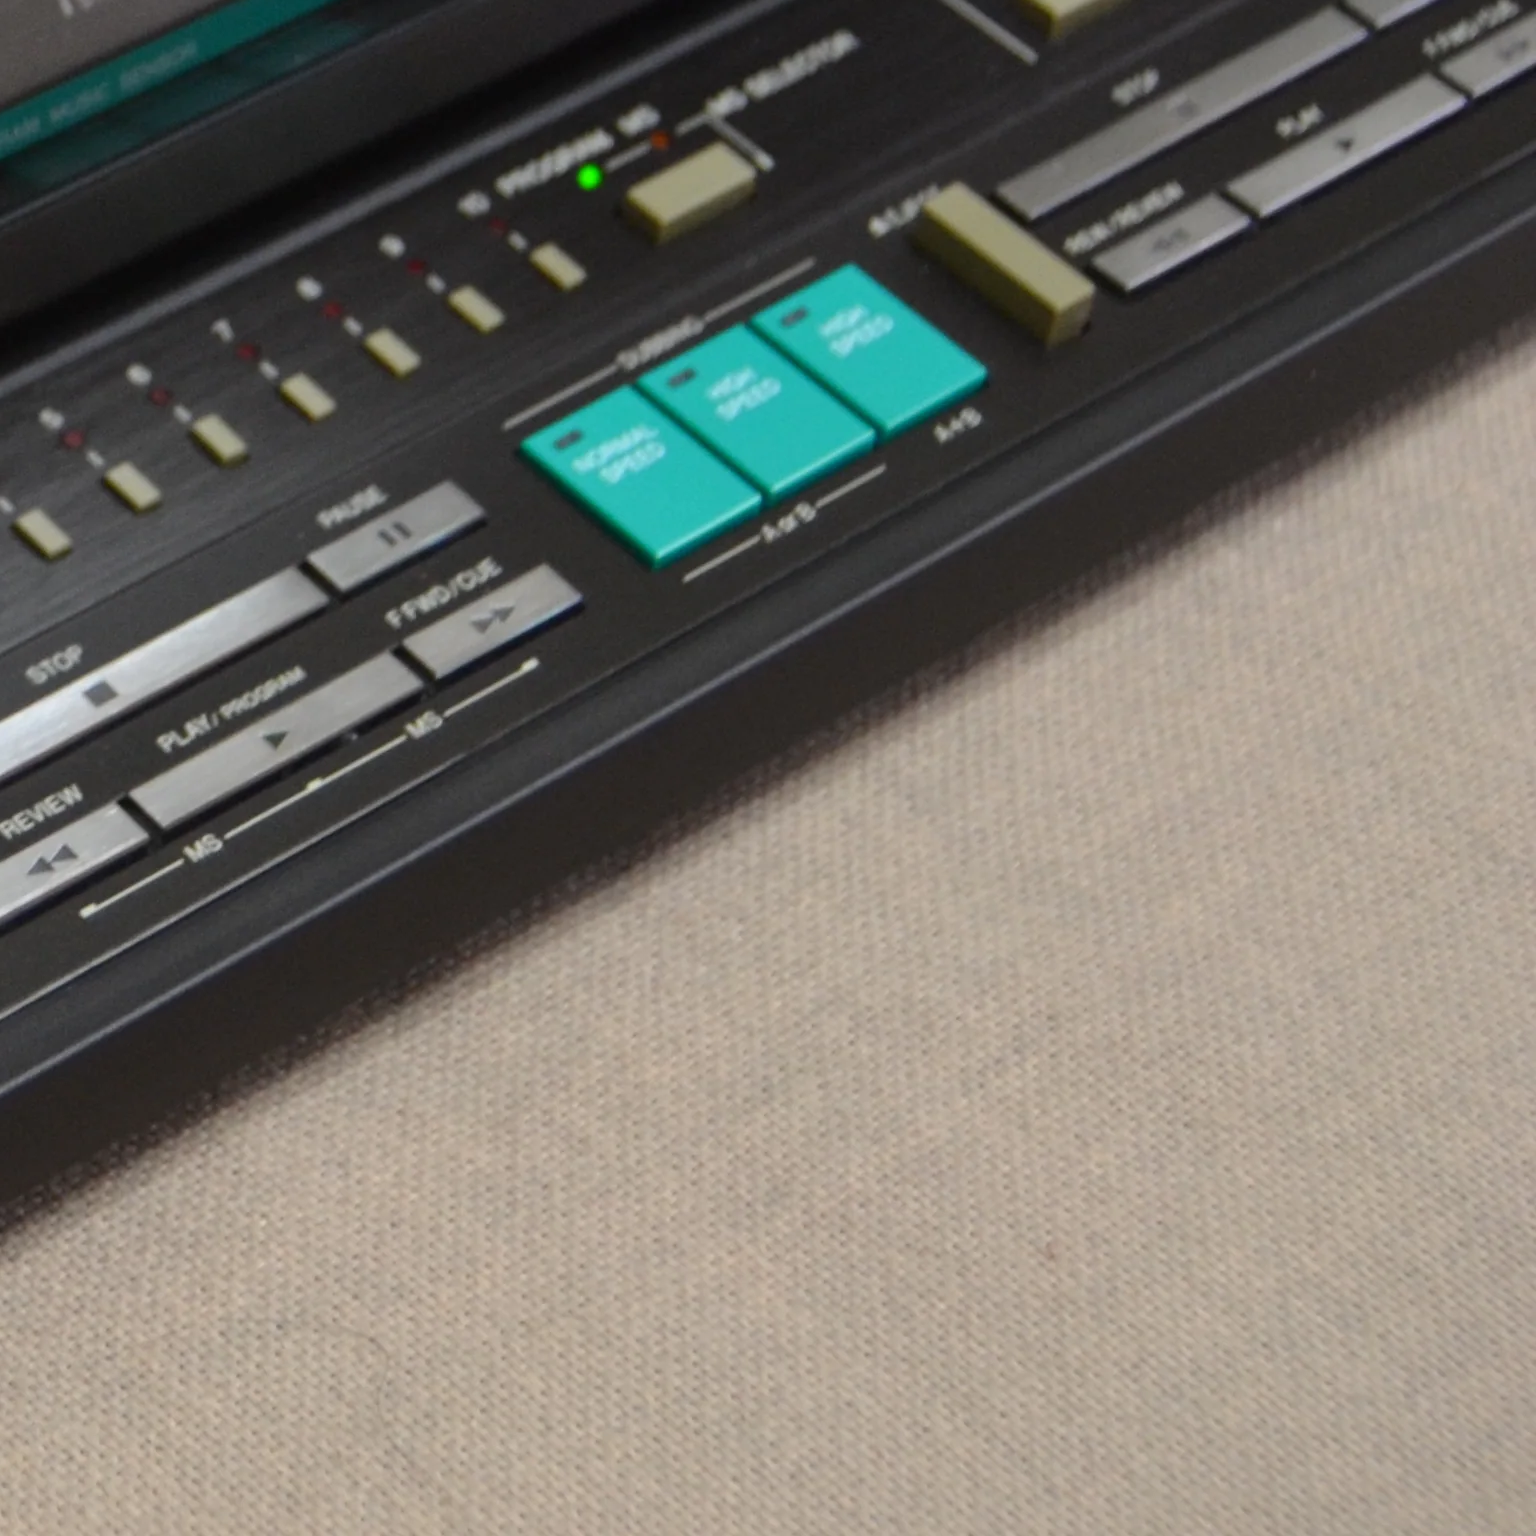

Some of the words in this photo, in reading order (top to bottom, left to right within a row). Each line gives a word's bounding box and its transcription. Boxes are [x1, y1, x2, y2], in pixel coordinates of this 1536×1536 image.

[829, 312, 895, 357] SPEED
[716, 376, 782, 422] SPEED
[599, 440, 667, 485] SPEED
[315, 483, 391, 531] PAUSE
[25, 643, 83, 685] STOP
[404, 709, 446, 742] MS
[182, 832, 225, 866] MS
